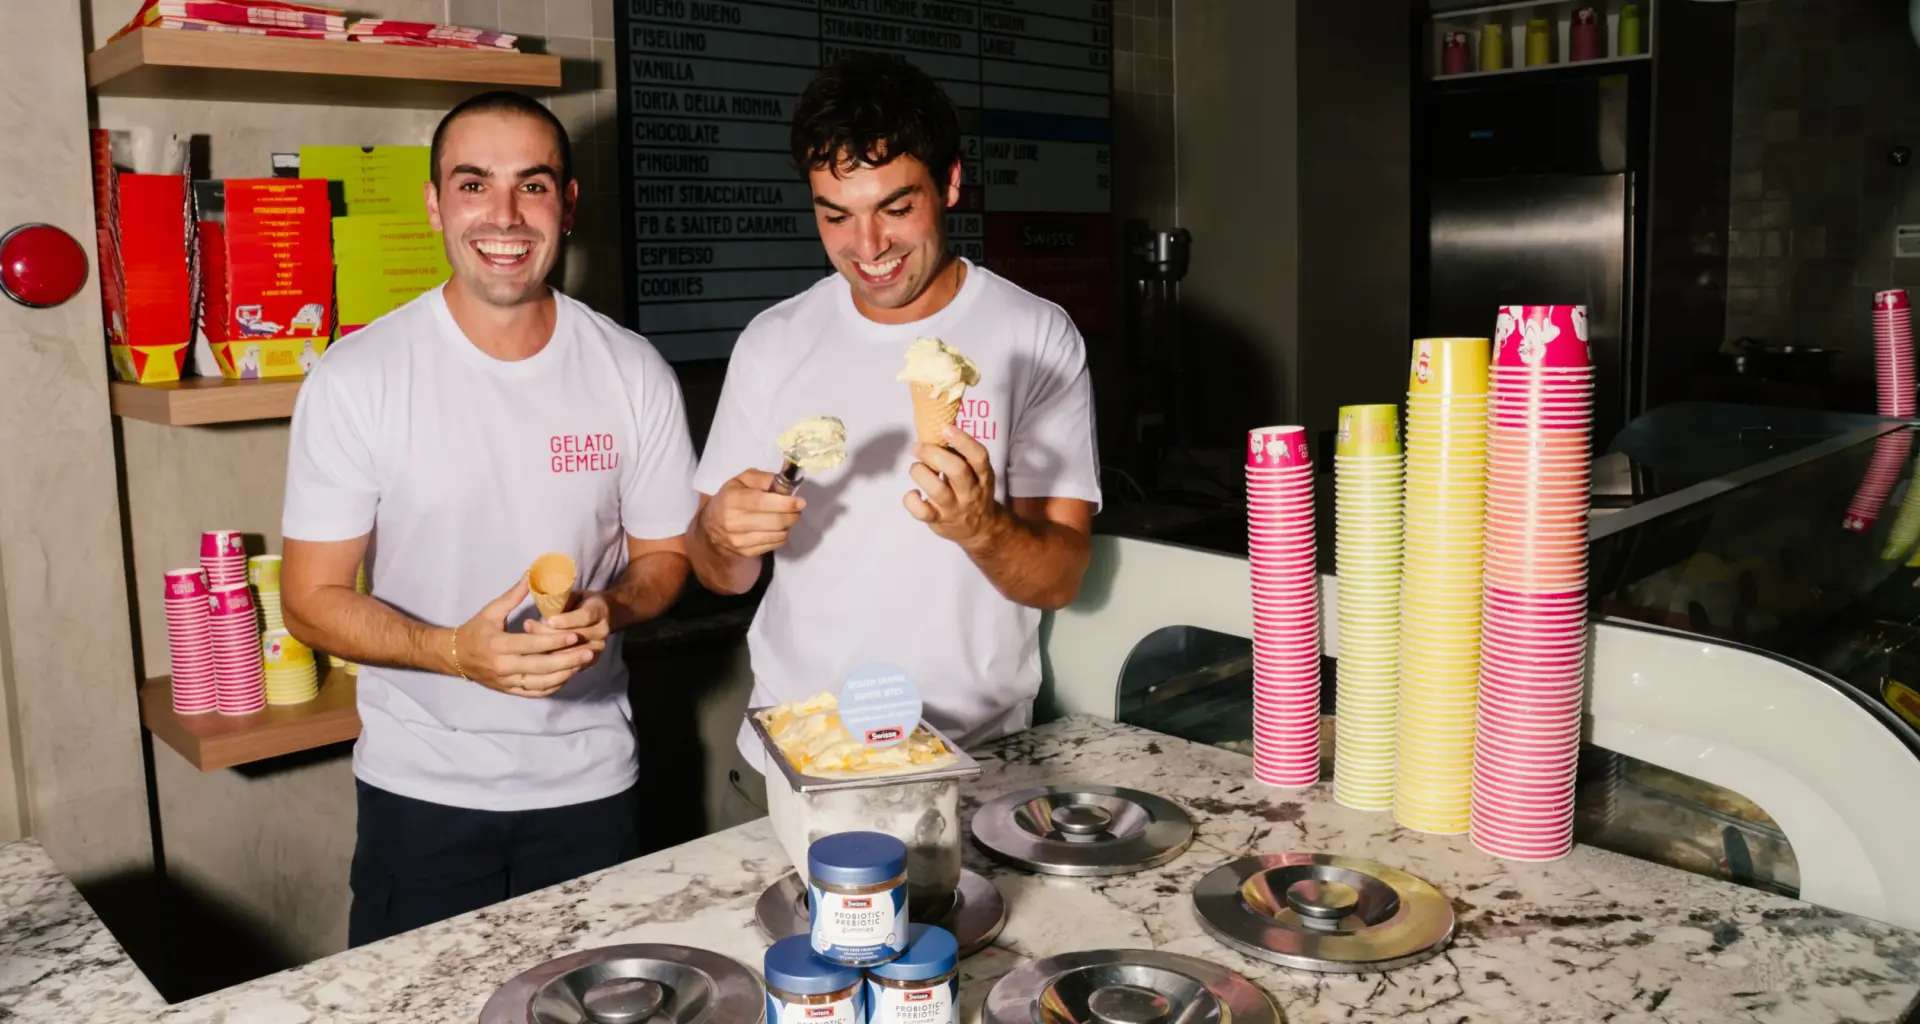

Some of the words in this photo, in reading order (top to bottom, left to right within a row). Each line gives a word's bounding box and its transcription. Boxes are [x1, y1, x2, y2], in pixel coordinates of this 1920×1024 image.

[632, 0, 685, 19] BUENO
[691, 3, 741, 25] BUENO
[921, 3, 973, 25] SORBETTO
[982, 12, 1025, 32] MEDIUM
[632, 28, 707, 51] PISELLINO
[824, 18, 902, 42] STRAWBERRY
[905, 28, 962, 49] SORBETTO
[983, 38, 1016, 56] LARGE
[633, 59, 694, 81] VANILLA
[634, 90, 680, 111] TORTA
[684, 94, 727, 114] DELLA
[732, 97, 782, 116] NONNA
[635, 122, 720, 143] CHOCOLATE
[636, 153, 709, 173] PINGUINO
[638, 185, 675, 204] MINT
[679, 185, 783, 204] STRACCIATELLA
[639, 216, 659, 235] PB
[665, 217, 675, 234] &
[681, 216, 732, 234] SALTED
[737, 216, 799, 234] CARAMEL
[1022, 226, 1076, 247] Swisse
[640, 247, 714, 265] ESPRESSO
[641, 277, 703, 296] COOKIES
[959, 400, 989, 418] ATO
[550, 433, 613, 453] GELATO
[551, 452, 619, 473] GEMELLI
[871, 731, 897, 740] Swisse
[836, 918, 880, 926] PREBIOTIC
[896, 1008, 940, 1019] PREBIOTIC
